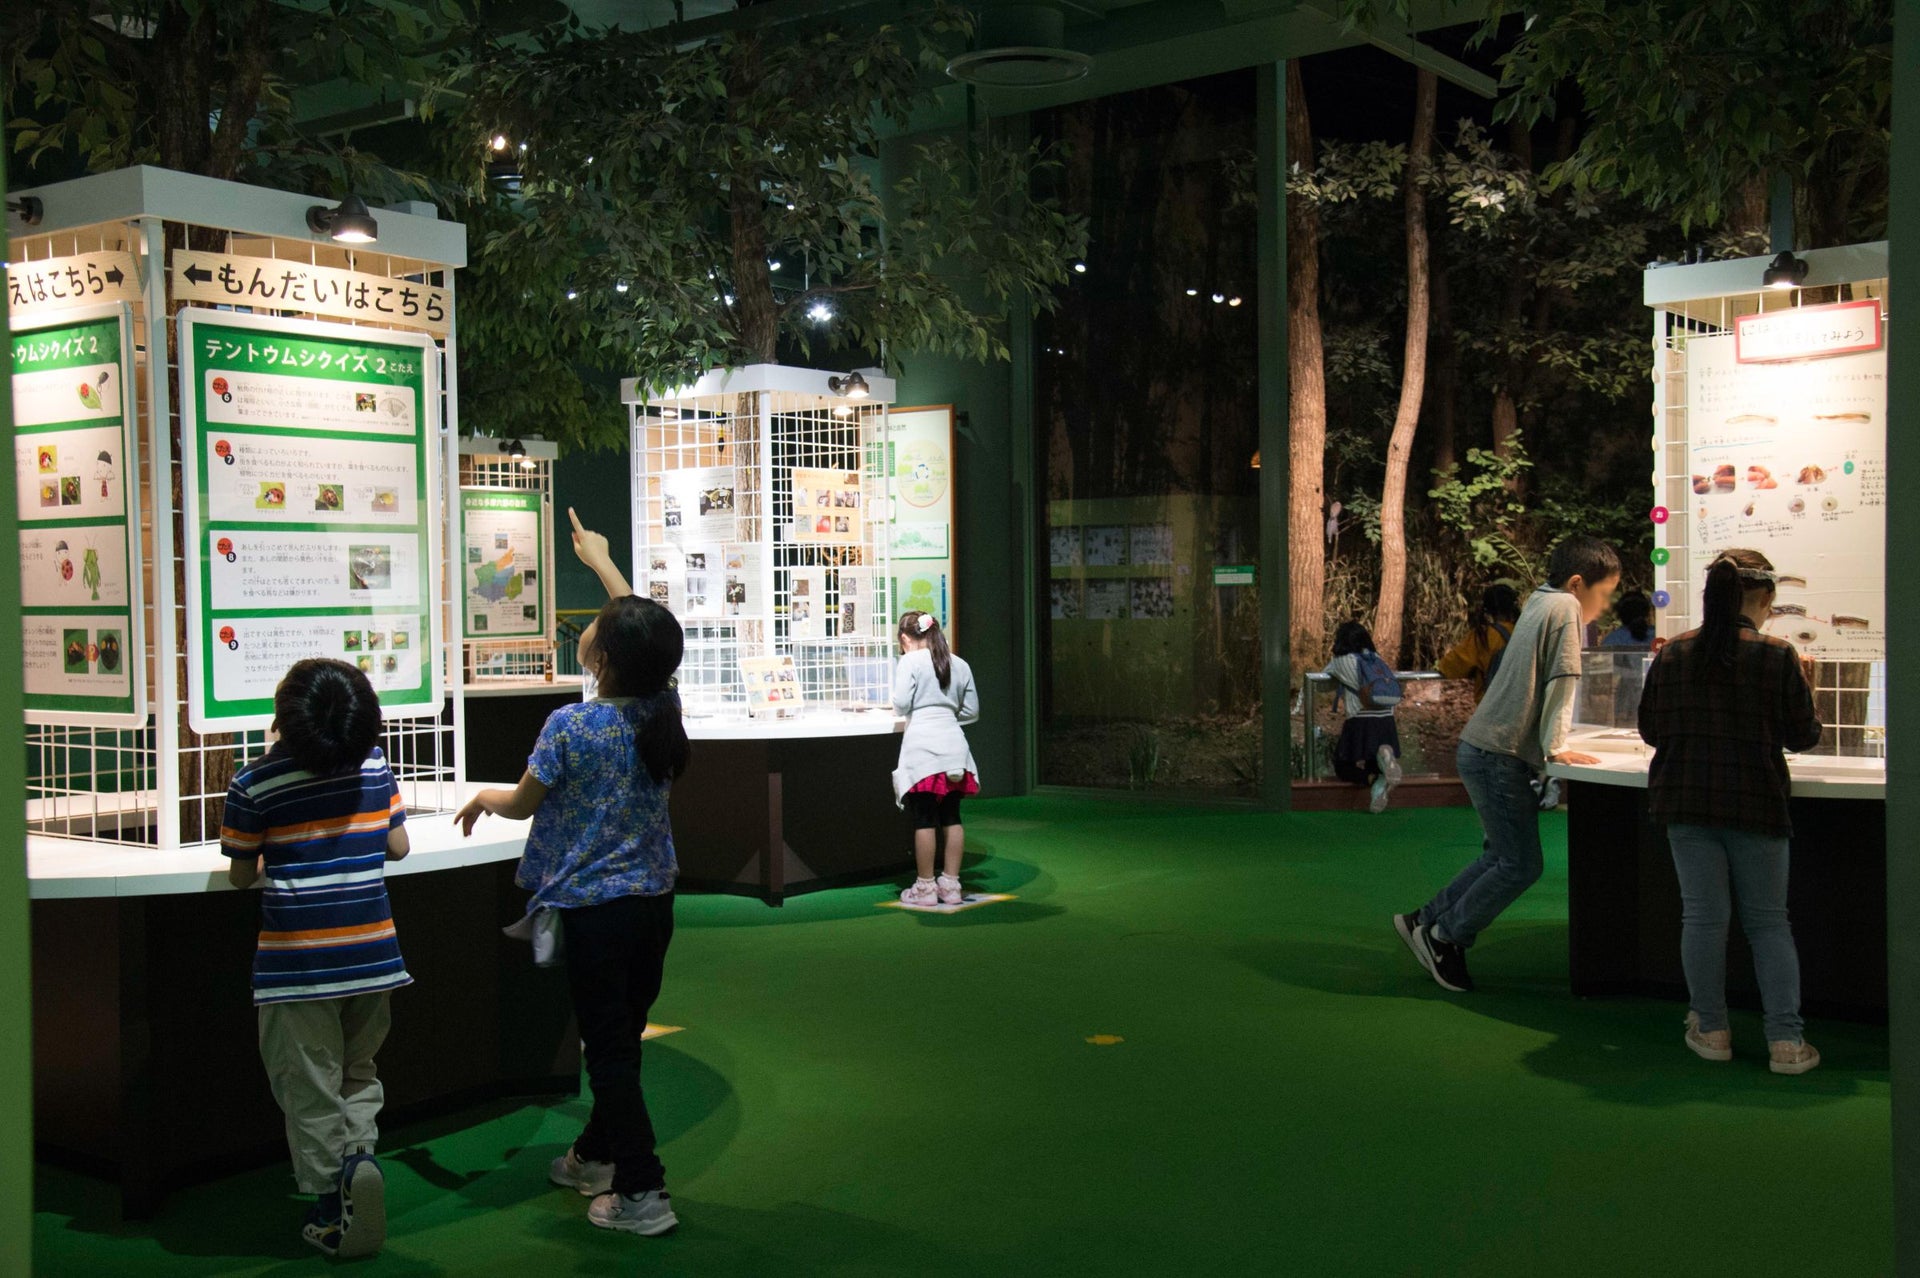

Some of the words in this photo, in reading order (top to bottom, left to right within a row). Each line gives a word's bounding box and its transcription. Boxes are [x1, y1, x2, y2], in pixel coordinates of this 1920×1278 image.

[218, 263, 444, 321] もんだいはこちら
[90, 336, 98, 354] 2
[206, 339, 369, 374] テントウムシクイズ
[376, 358, 386, 374] 2
[390, 363, 414, 374] こたえ
[224, 393, 230, 402] 6
[229, 553, 235, 561] 8
